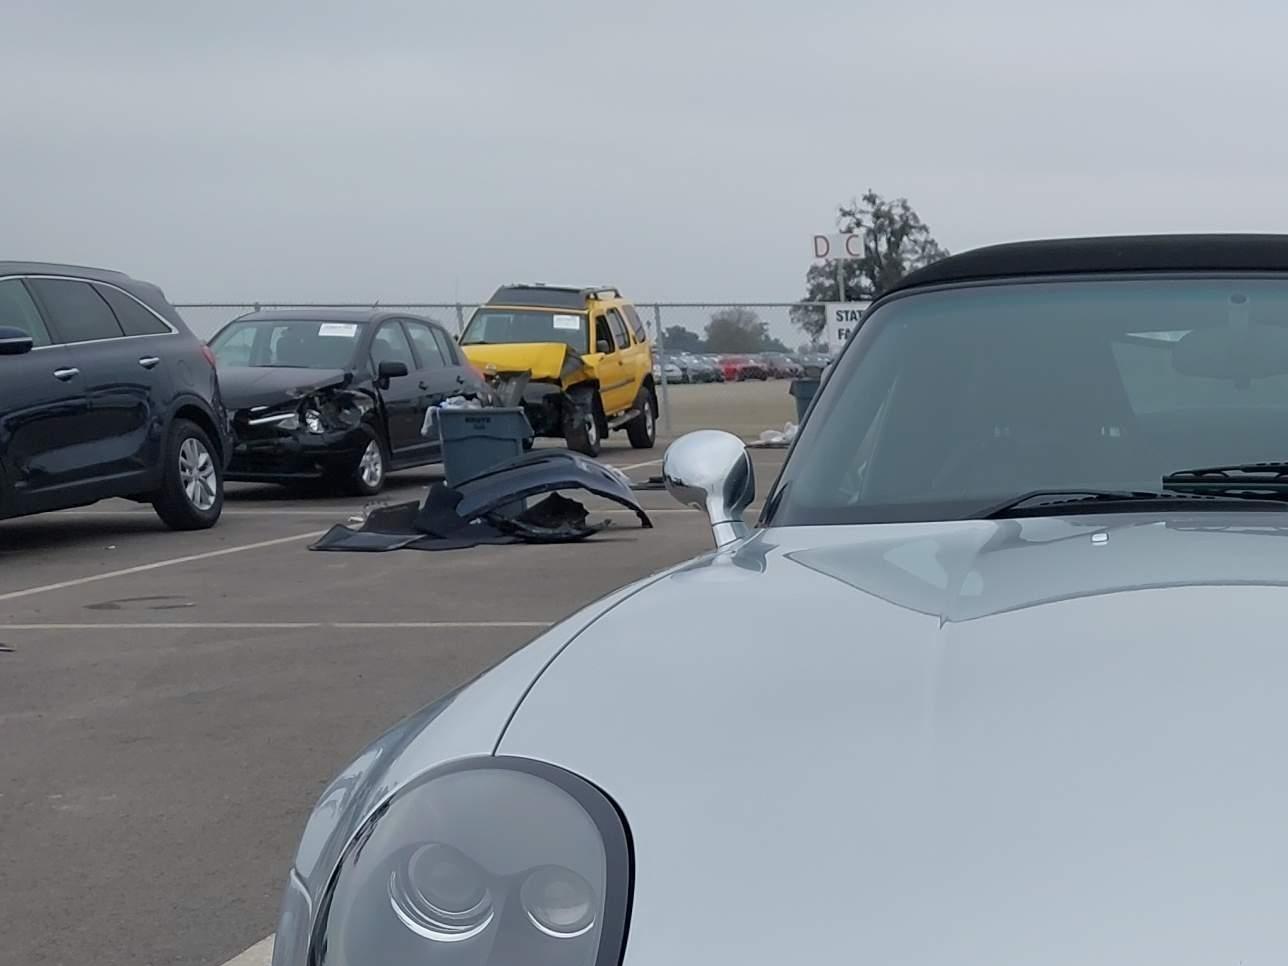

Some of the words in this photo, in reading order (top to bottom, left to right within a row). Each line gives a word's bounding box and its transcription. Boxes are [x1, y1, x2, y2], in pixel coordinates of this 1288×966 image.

[814, 235, 830, 258] D
[845, 234, 861, 257] C
[836, 310, 865, 322] STAT
